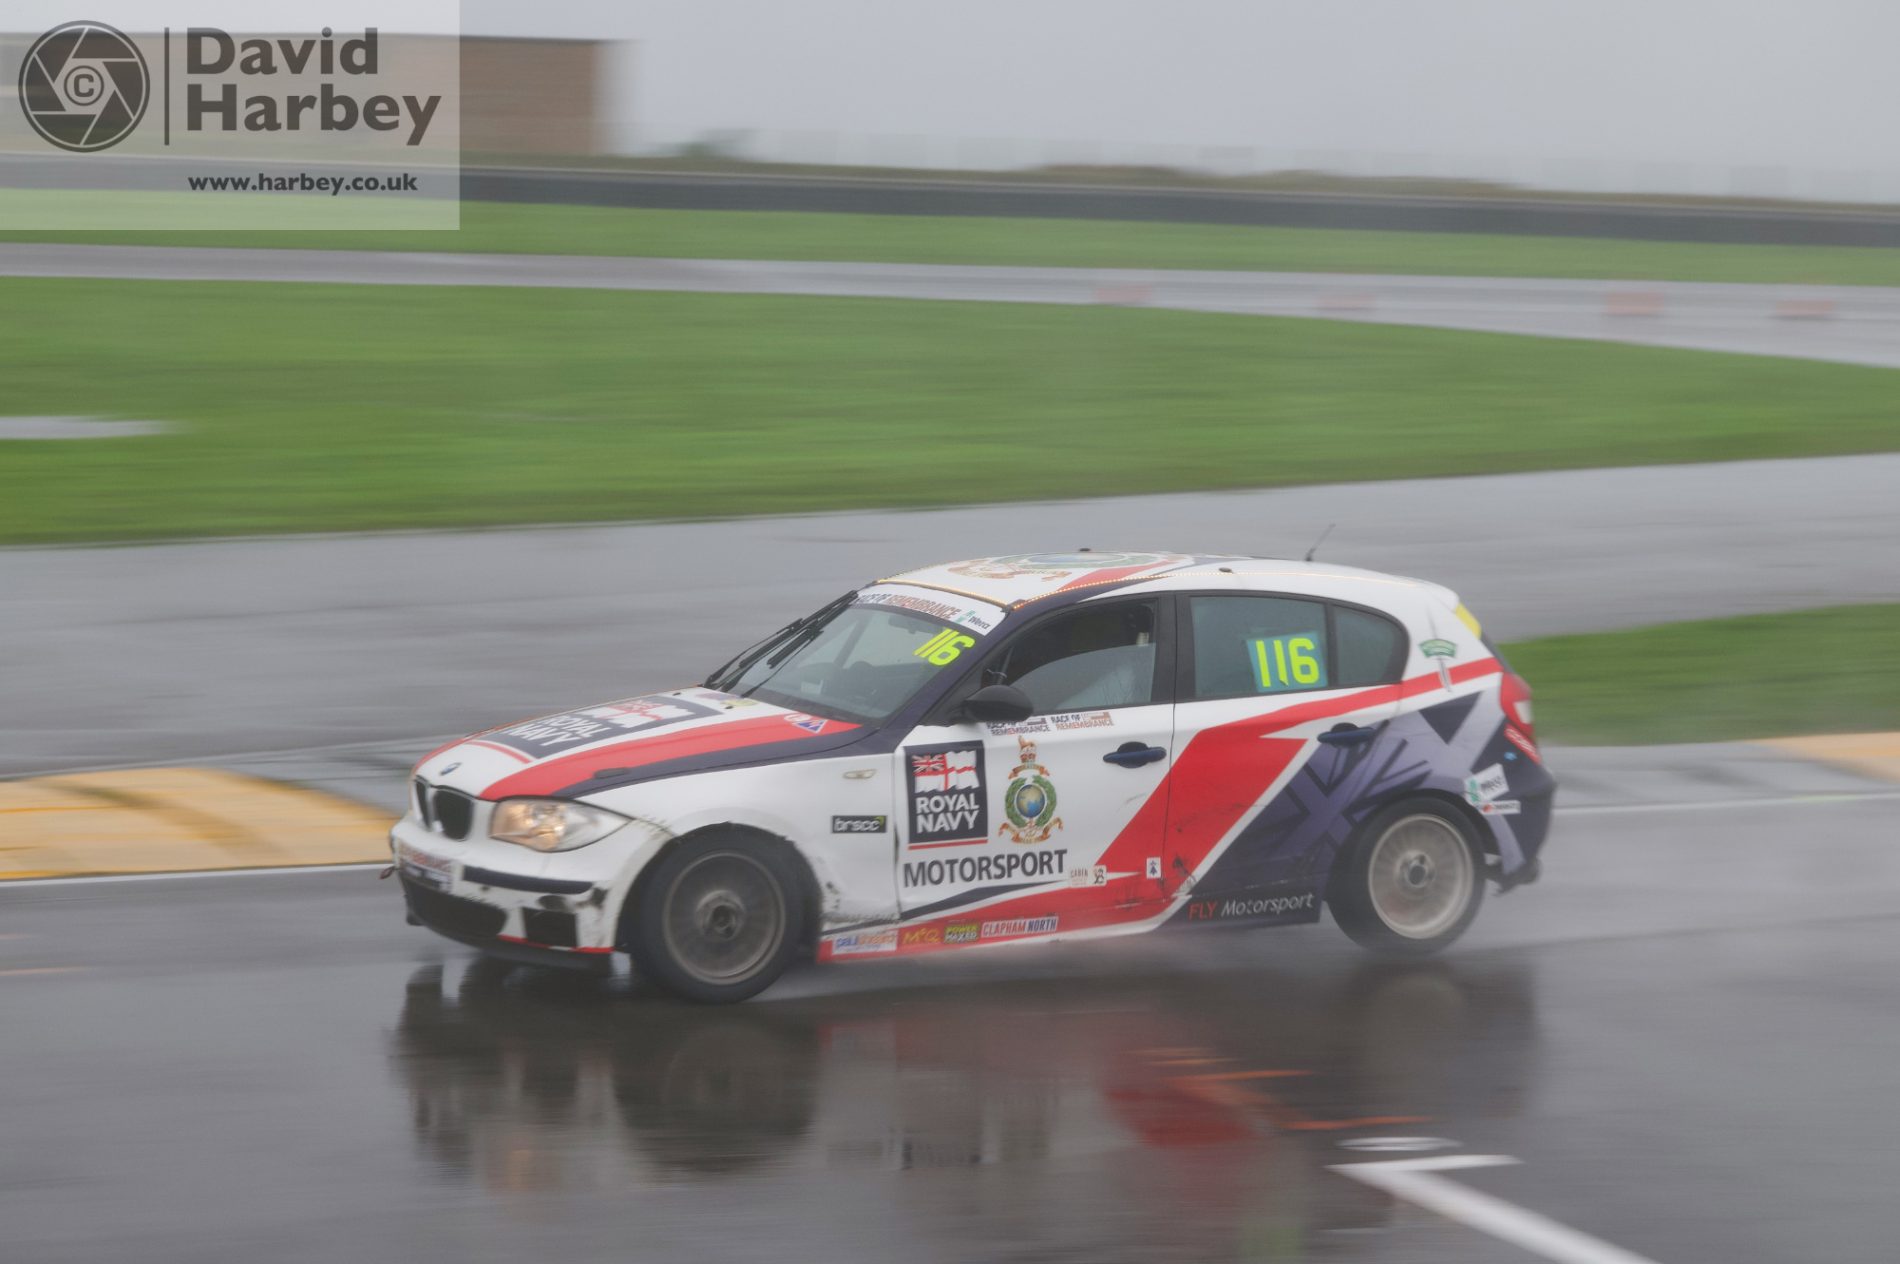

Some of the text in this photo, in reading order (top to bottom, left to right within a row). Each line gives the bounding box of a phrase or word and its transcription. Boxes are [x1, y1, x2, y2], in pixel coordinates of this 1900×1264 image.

[912, 628, 976, 666] 116
[1255, 637, 1320, 687] 116
[500, 722, 580, 747] NAVY
[536, 714, 612, 739] ROYAL
[915, 793, 980, 815] ROYAL
[916, 810, 980, 834] NAVY
[903, 849, 1068, 888] MOTORSPORT
[1189, 893, 1315, 920] FLY Motorsport
[982, 918, 1057, 938] CLAPHAM NORTH
